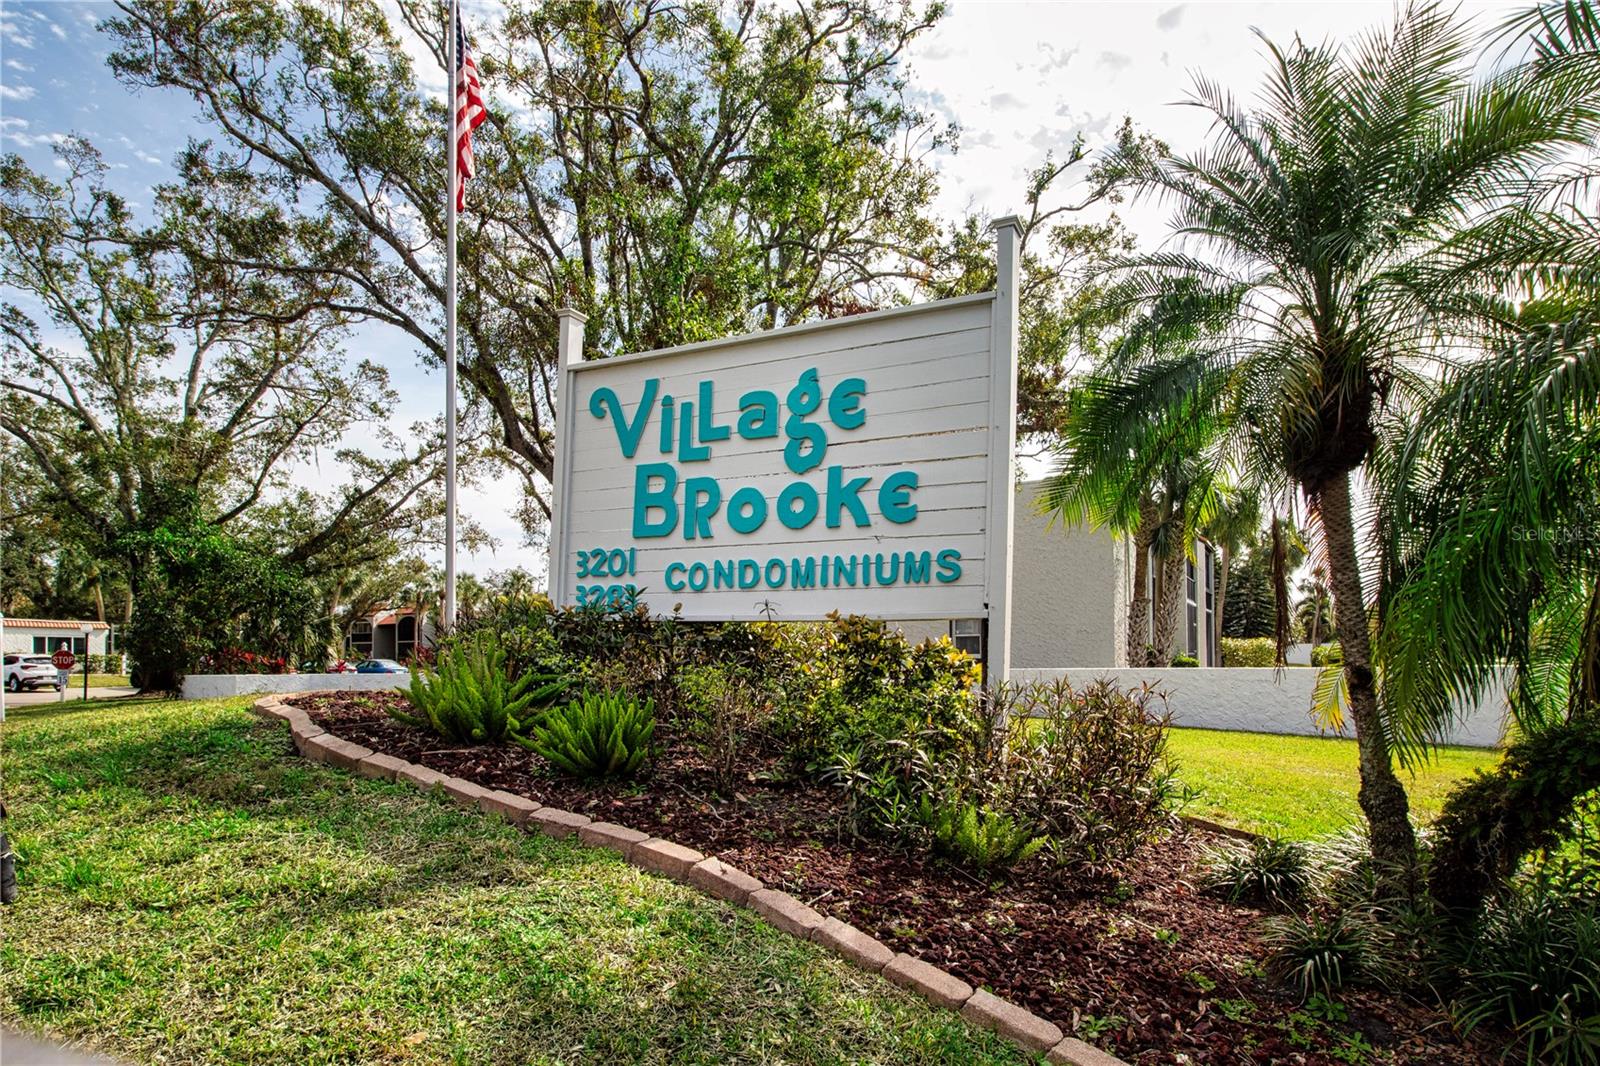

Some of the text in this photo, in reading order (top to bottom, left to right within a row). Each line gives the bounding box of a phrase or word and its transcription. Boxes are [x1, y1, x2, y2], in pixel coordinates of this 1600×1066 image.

[576, 547, 636, 578] 3201
[665, 549, 963, 592] CONDOMINIUMS
[52, 656, 74, 664] STOP
